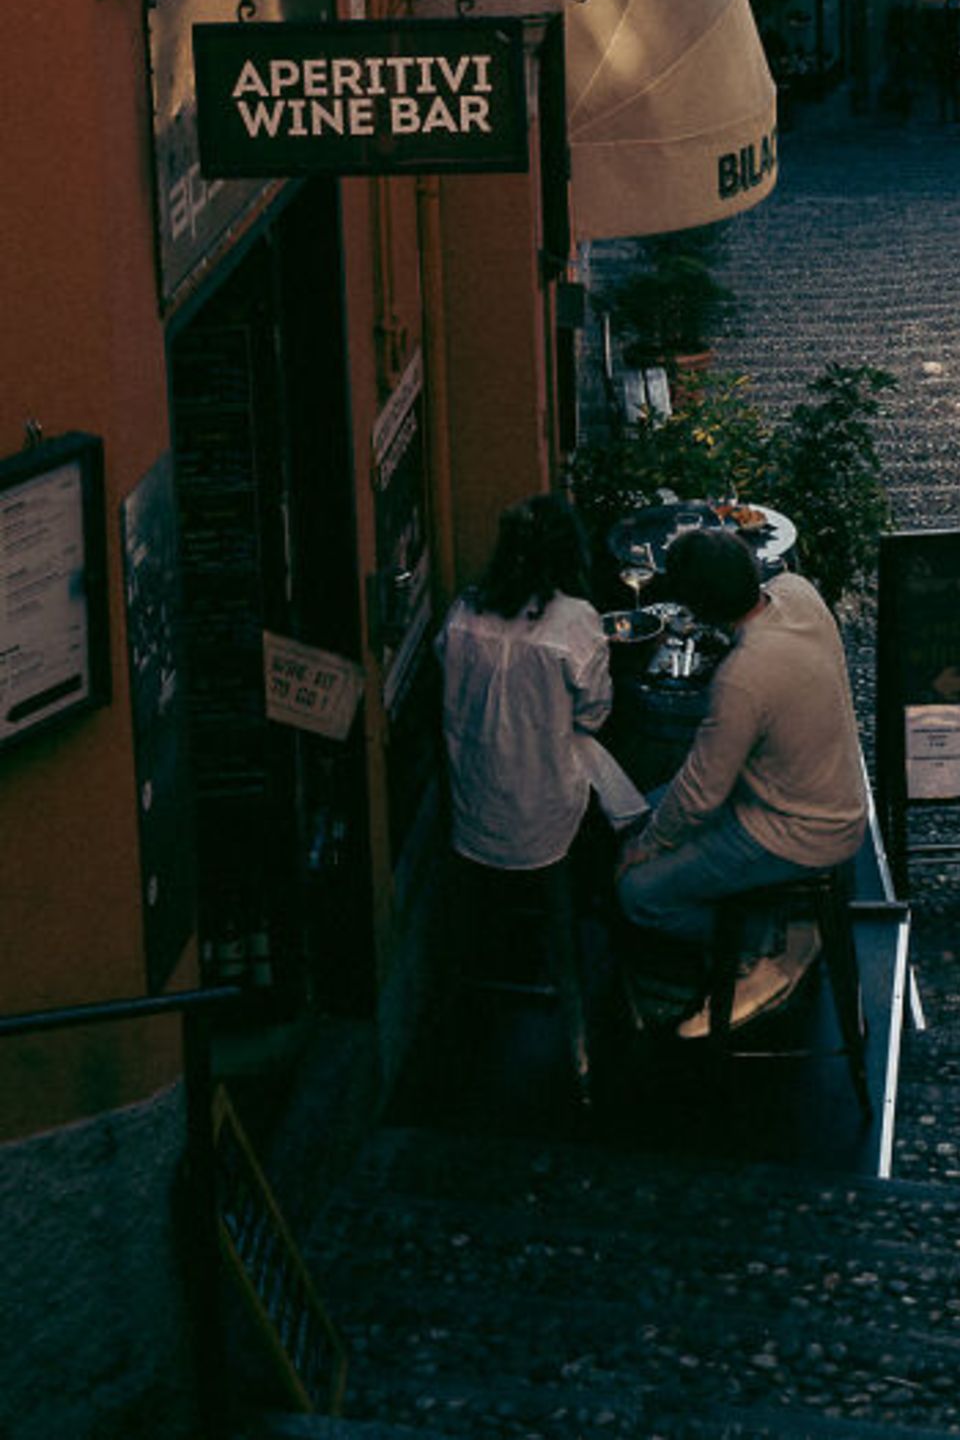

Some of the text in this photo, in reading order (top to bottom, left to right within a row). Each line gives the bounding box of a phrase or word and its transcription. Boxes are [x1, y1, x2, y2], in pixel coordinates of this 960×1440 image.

[232, 56, 493, 97] APERITIVI
[237, 96, 493, 137] WINE BAR
[718, 133, 774, 199] BILA
